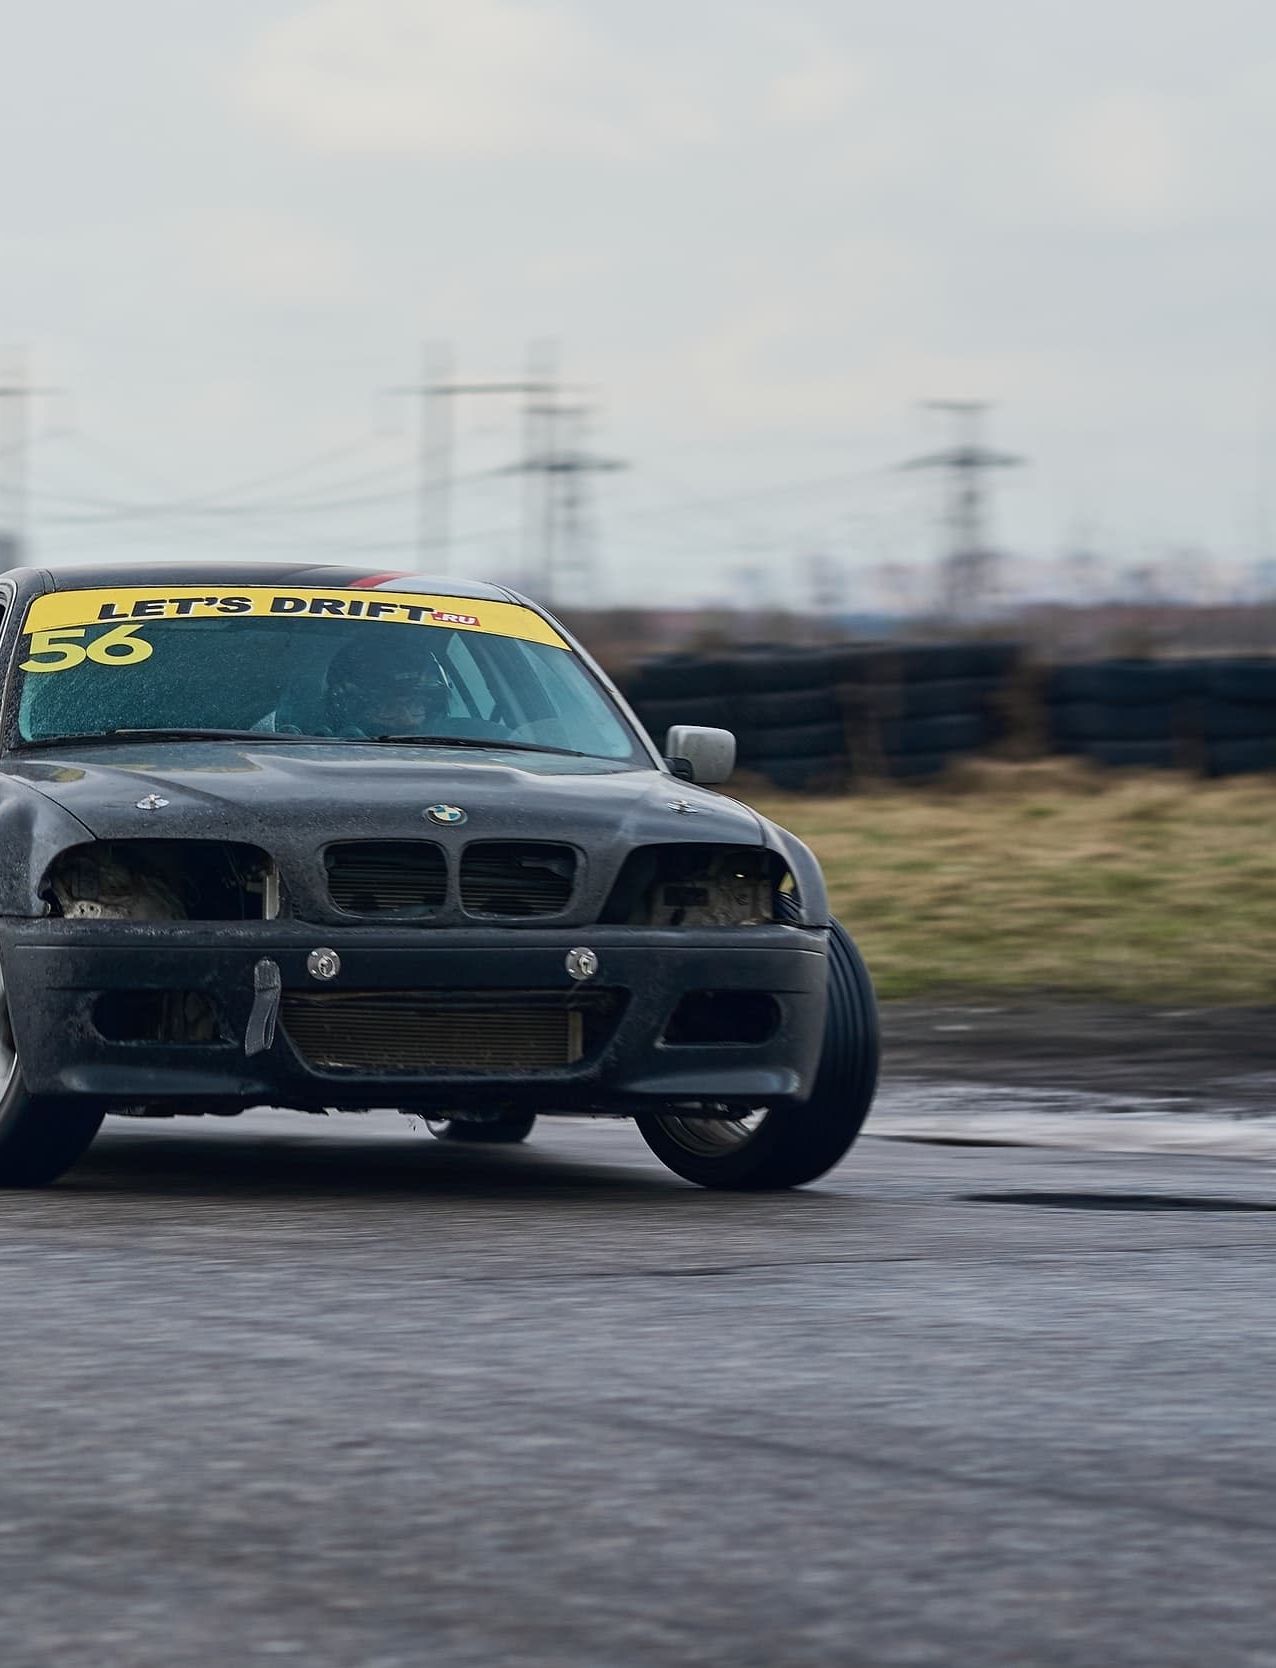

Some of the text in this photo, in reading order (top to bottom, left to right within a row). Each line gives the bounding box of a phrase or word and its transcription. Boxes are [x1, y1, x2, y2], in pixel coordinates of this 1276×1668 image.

[97, 597, 252, 620] LET'S
[270, 597, 434, 621] DRIFT
[19, 624, 154, 673] 56
